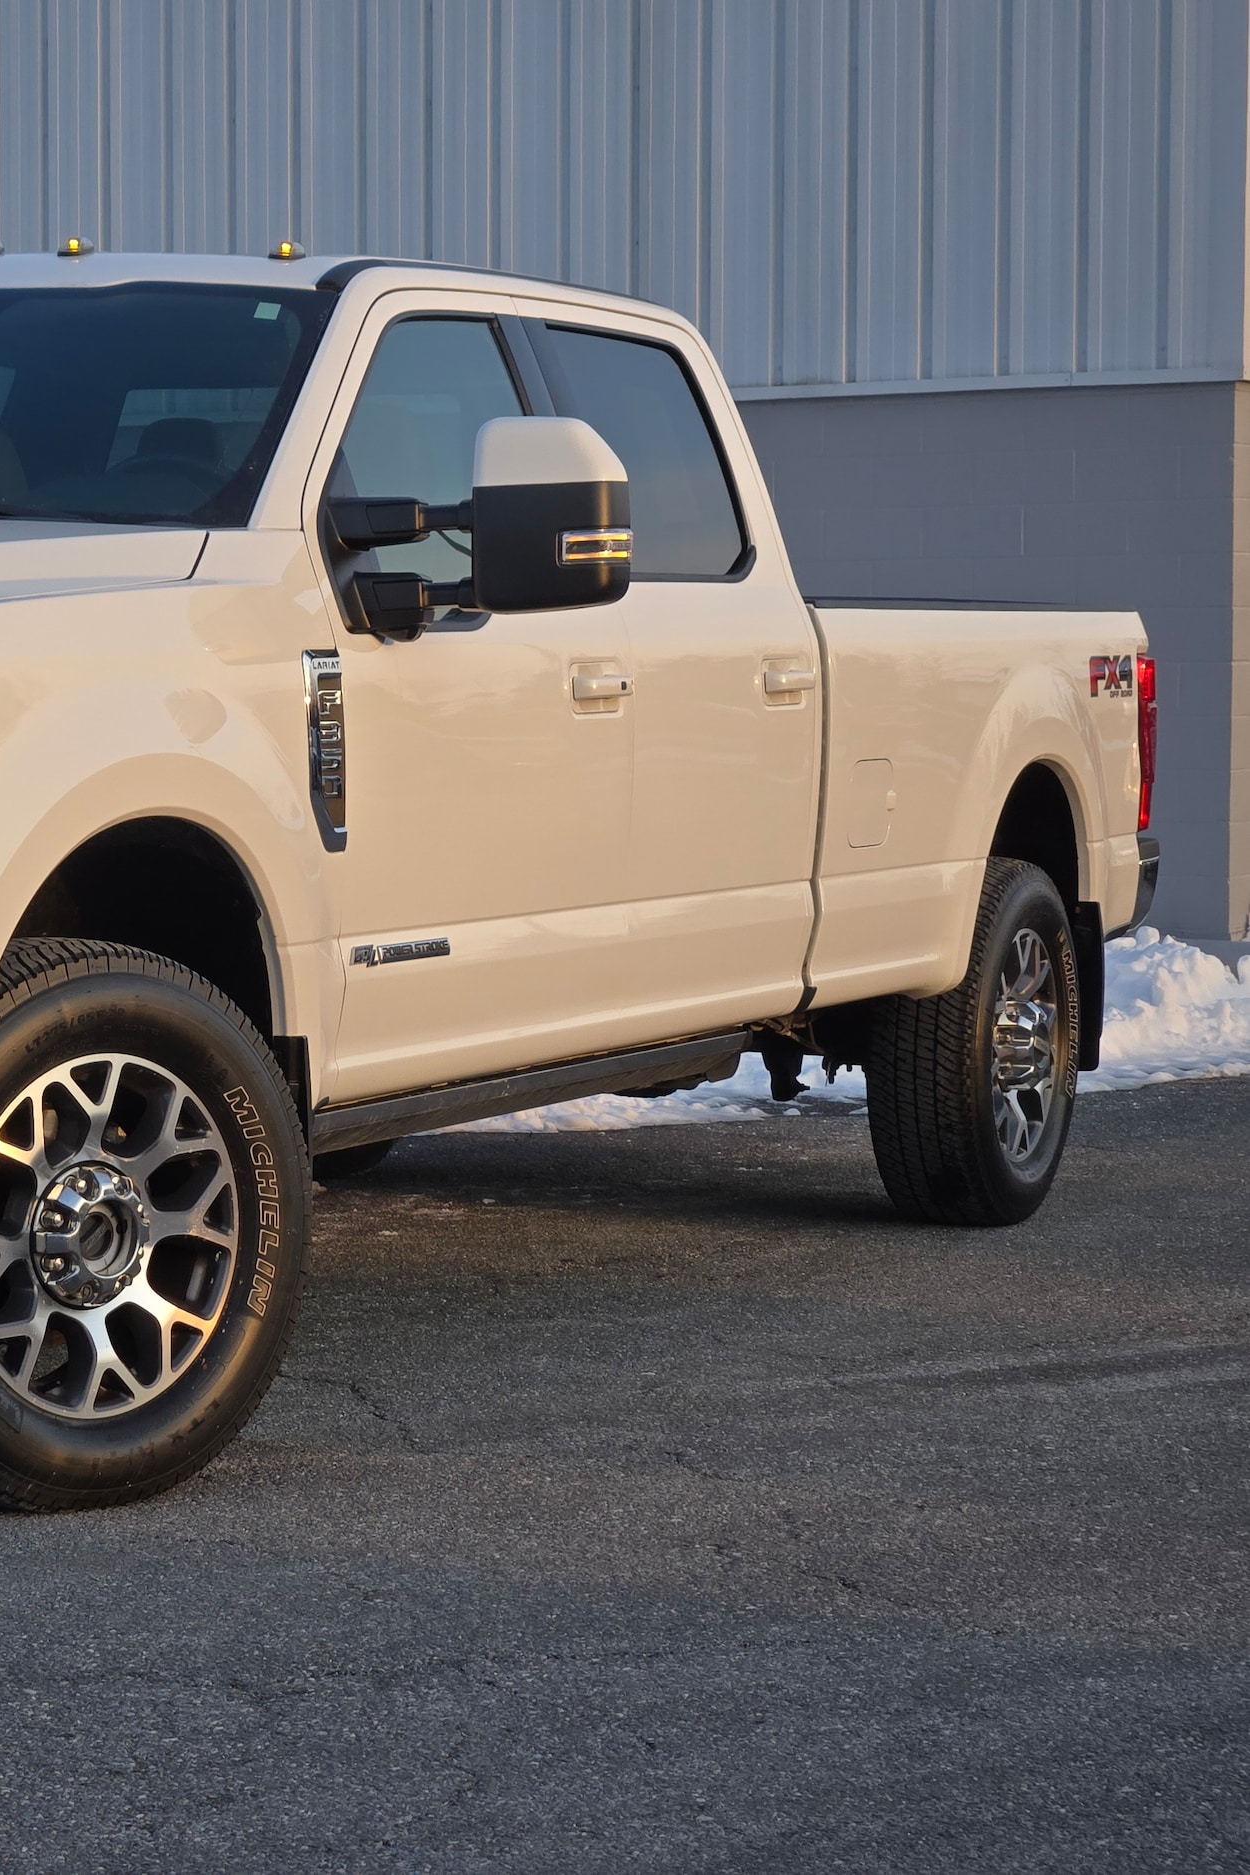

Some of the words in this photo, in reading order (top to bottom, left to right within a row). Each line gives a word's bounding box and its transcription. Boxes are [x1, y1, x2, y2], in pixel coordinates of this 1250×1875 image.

[312, 661, 340, 670] LARIAT
[1089, 655, 1132, 697] FX4
[382, 944, 414, 958] POWER
[414, 940, 449, 954] STROKE
[1062, 949, 1079, 1099] MICHELIN
[222, 1086, 280, 1317] MICHELIN
